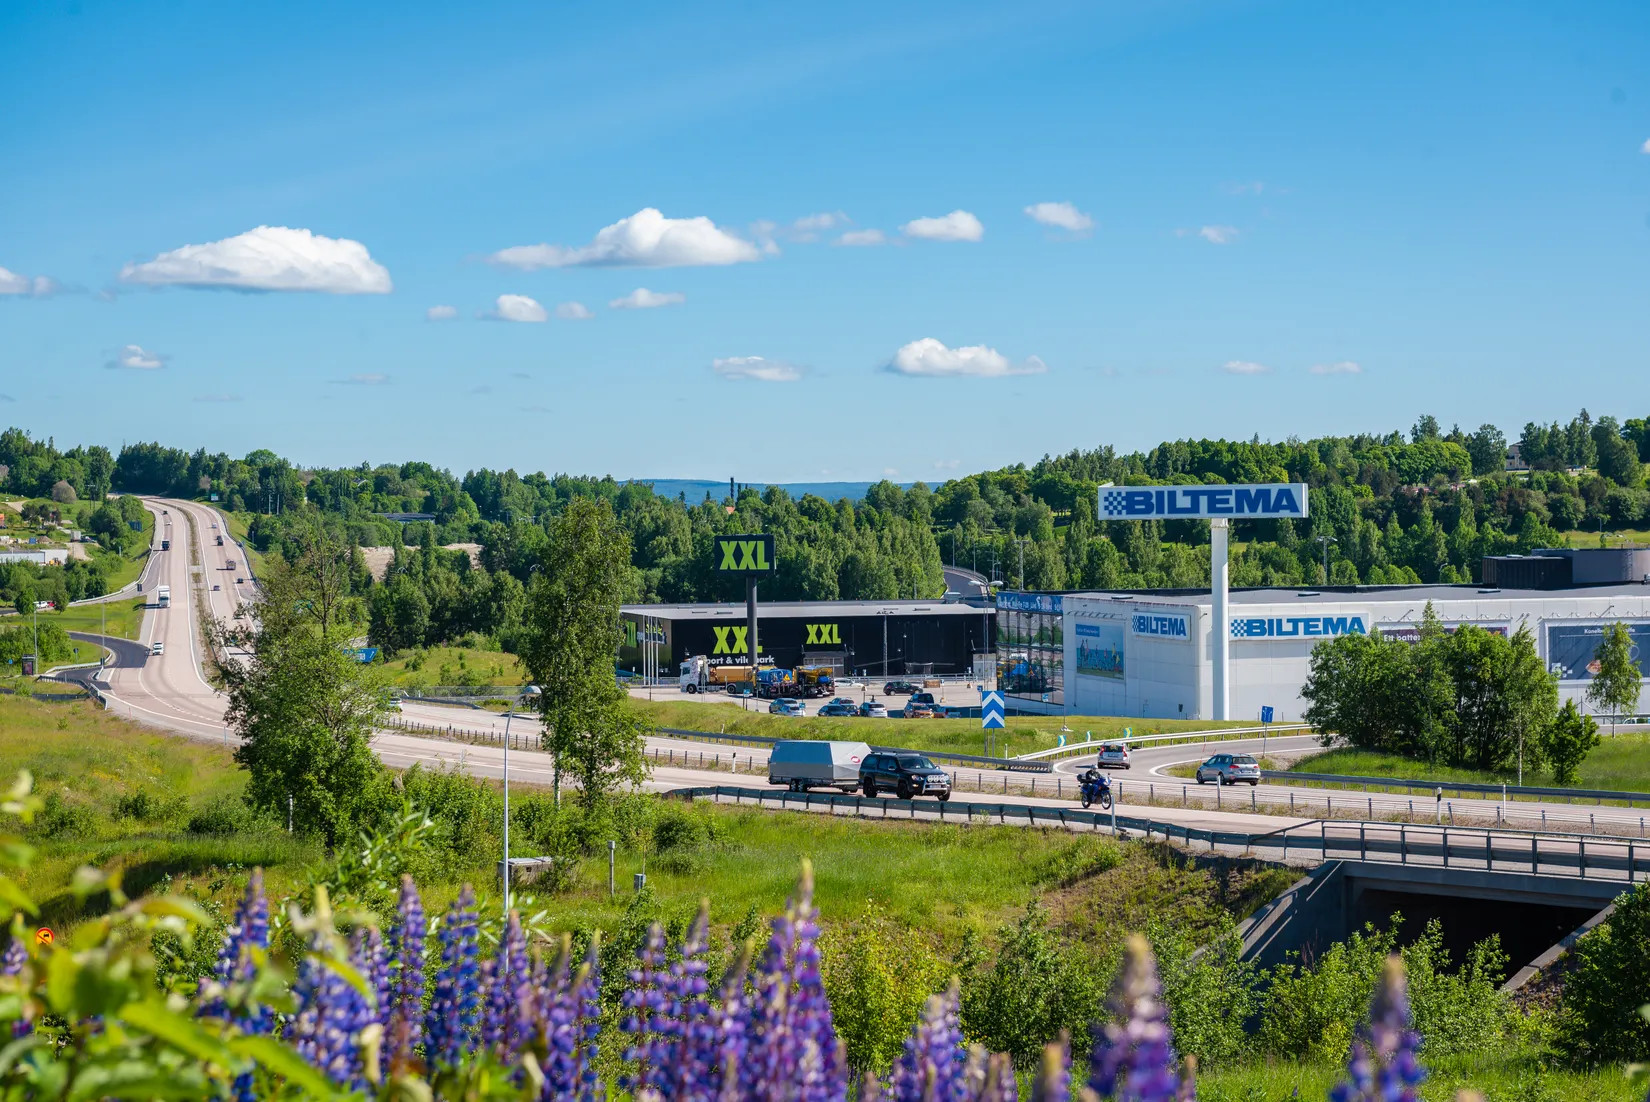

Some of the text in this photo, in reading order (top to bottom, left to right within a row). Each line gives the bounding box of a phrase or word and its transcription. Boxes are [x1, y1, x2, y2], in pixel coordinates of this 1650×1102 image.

[1126, 488, 1300, 515] BILTEMA
[719, 541, 770, 570] XXL
[805, 623, 842, 645] XXL
[1138, 615, 1187, 636] BILTEMA
[1246, 617, 1366, 637] BILTEMA
[706, 656, 724, 666] port
[726, 656, 733, 665] &
